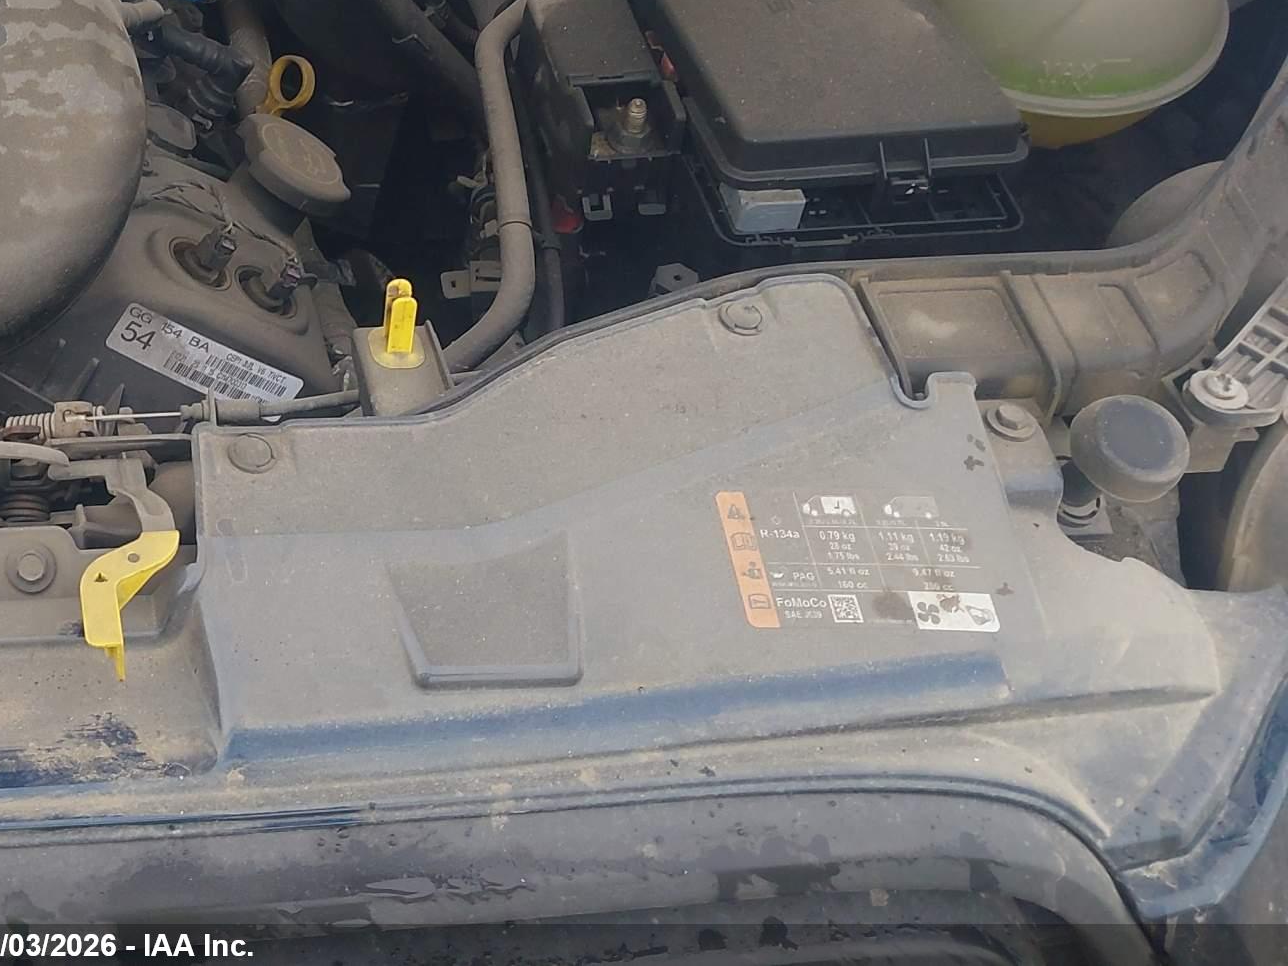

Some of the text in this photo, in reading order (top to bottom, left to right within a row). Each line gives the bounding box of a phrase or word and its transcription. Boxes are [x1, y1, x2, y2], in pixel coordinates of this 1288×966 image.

[121, 320, 155, 351] 54
[129, 307, 153, 324] GG
[189, 336, 210, 353] BA
[760, 530, 800, 539] R-134a
[819, 531, 855, 542] 0.79 kg
[777, 597, 827, 608] FoMoCo
